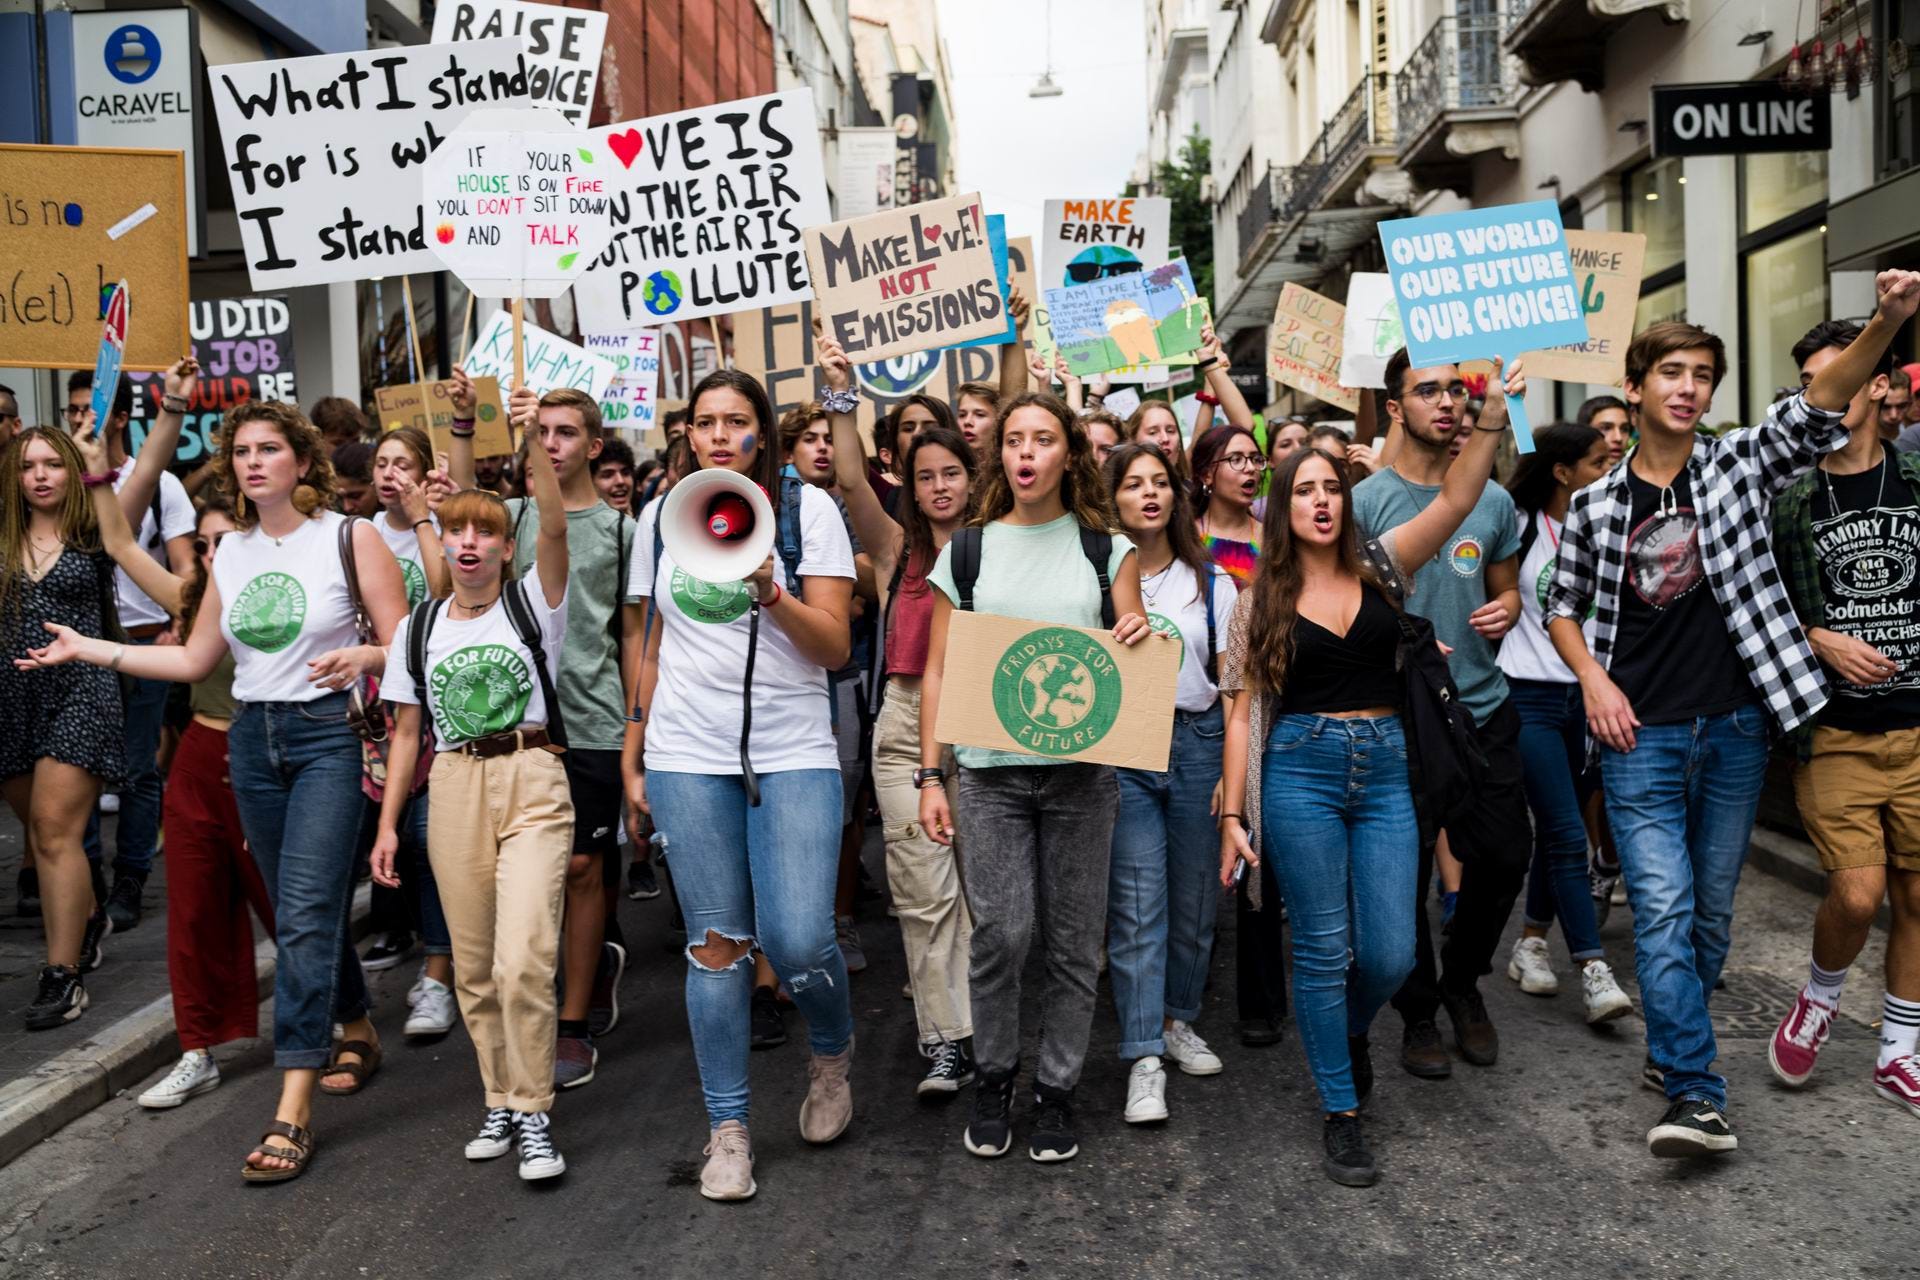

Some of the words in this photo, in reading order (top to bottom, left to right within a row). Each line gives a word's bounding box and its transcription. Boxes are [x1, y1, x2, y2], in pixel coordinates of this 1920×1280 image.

[452, 4, 587, 61] RAISE
[222, 58, 369, 119] What
[371, 56, 416, 110] I
[428, 53, 528, 110] stand
[79, 92, 190, 117] CARAVEL
[1673, 103, 1730, 140] ON
[1739, 99, 1813, 136] LINE
[715, 99, 793, 160] IS
[231, 134, 306, 195] for
[325, 143, 360, 178] is
[467, 146, 486, 167] IF
[527, 151, 572, 172] YOUR
[457, 174, 510, 193] HOUSE
[518, 175, 530, 192] IS
[538, 178, 557, 192] ON
[566, 177, 604, 193] FIRE
[636, 178, 706, 221] THE
[716, 163, 800, 211] AIR
[5, 193, 29, 226] is
[437, 200, 469, 216] YOU
[477, 197, 525, 214] DON'T
[534, 195, 559, 213] SIT
[569, 198, 607, 215] DOWN
[1063, 199, 1135, 224] MAKE
[240, 207, 297, 270] I
[318, 206, 428, 262] stand
[467, 226, 500, 246] AND
[527, 224, 579, 245] TALK
[585, 232, 629, 272] UT
[631, 222, 688, 261] THE
[696, 214, 752, 255] AIR
[757, 208, 801, 250] IS
[1060, 223, 1145, 249] EARTH
[1391, 232, 1456, 265] OUR
[1456, 219, 1559, 256] WORLD
[820, 226, 911, 288] MAKE
[1570, 248, 1623, 271] HANGE
[879, 263, 937, 299] NOT
[1065, 289, 1089, 301] AM
[1096, 283, 1127, 297] THE
[1400, 267, 1462, 299] OUR
[1462, 251, 1569, 290] FUTURE
[219, 298, 289, 338] DID
[832, 278, 1001, 349] EMISSIONS
[1409, 300, 1474, 343] OUR
[1474, 285, 1578, 333] CHOICE!
[209, 338, 280, 376] JOB
[588, 334, 628, 347] WHAT
[638, 336, 653, 351] I
[634, 356, 659, 371] FOR
[258, 372, 296, 404] BE
[633, 387, 648, 401] I
[600, 401, 629, 420] AND
[634, 404, 653, 420] ON
[1887, 539, 1914, 553] PLAY
[1890, 516, 1920, 551] LAN
[1855, 579, 1888, 589] BRAND
[231, 581, 259, 632] FRIDAYS
[260, 574, 286, 588] FOR
[697, 604, 738, 620] GREECE
[443, 650, 480, 673] FOR
[482, 648, 532, 692] FUTURE
[1001, 635, 1065, 677] FRIDAYS
[1084, 646, 1114, 677] FOR
[430, 671, 460, 742] FRIDAYS
[1018, 725, 1096, 750] FUTURE
